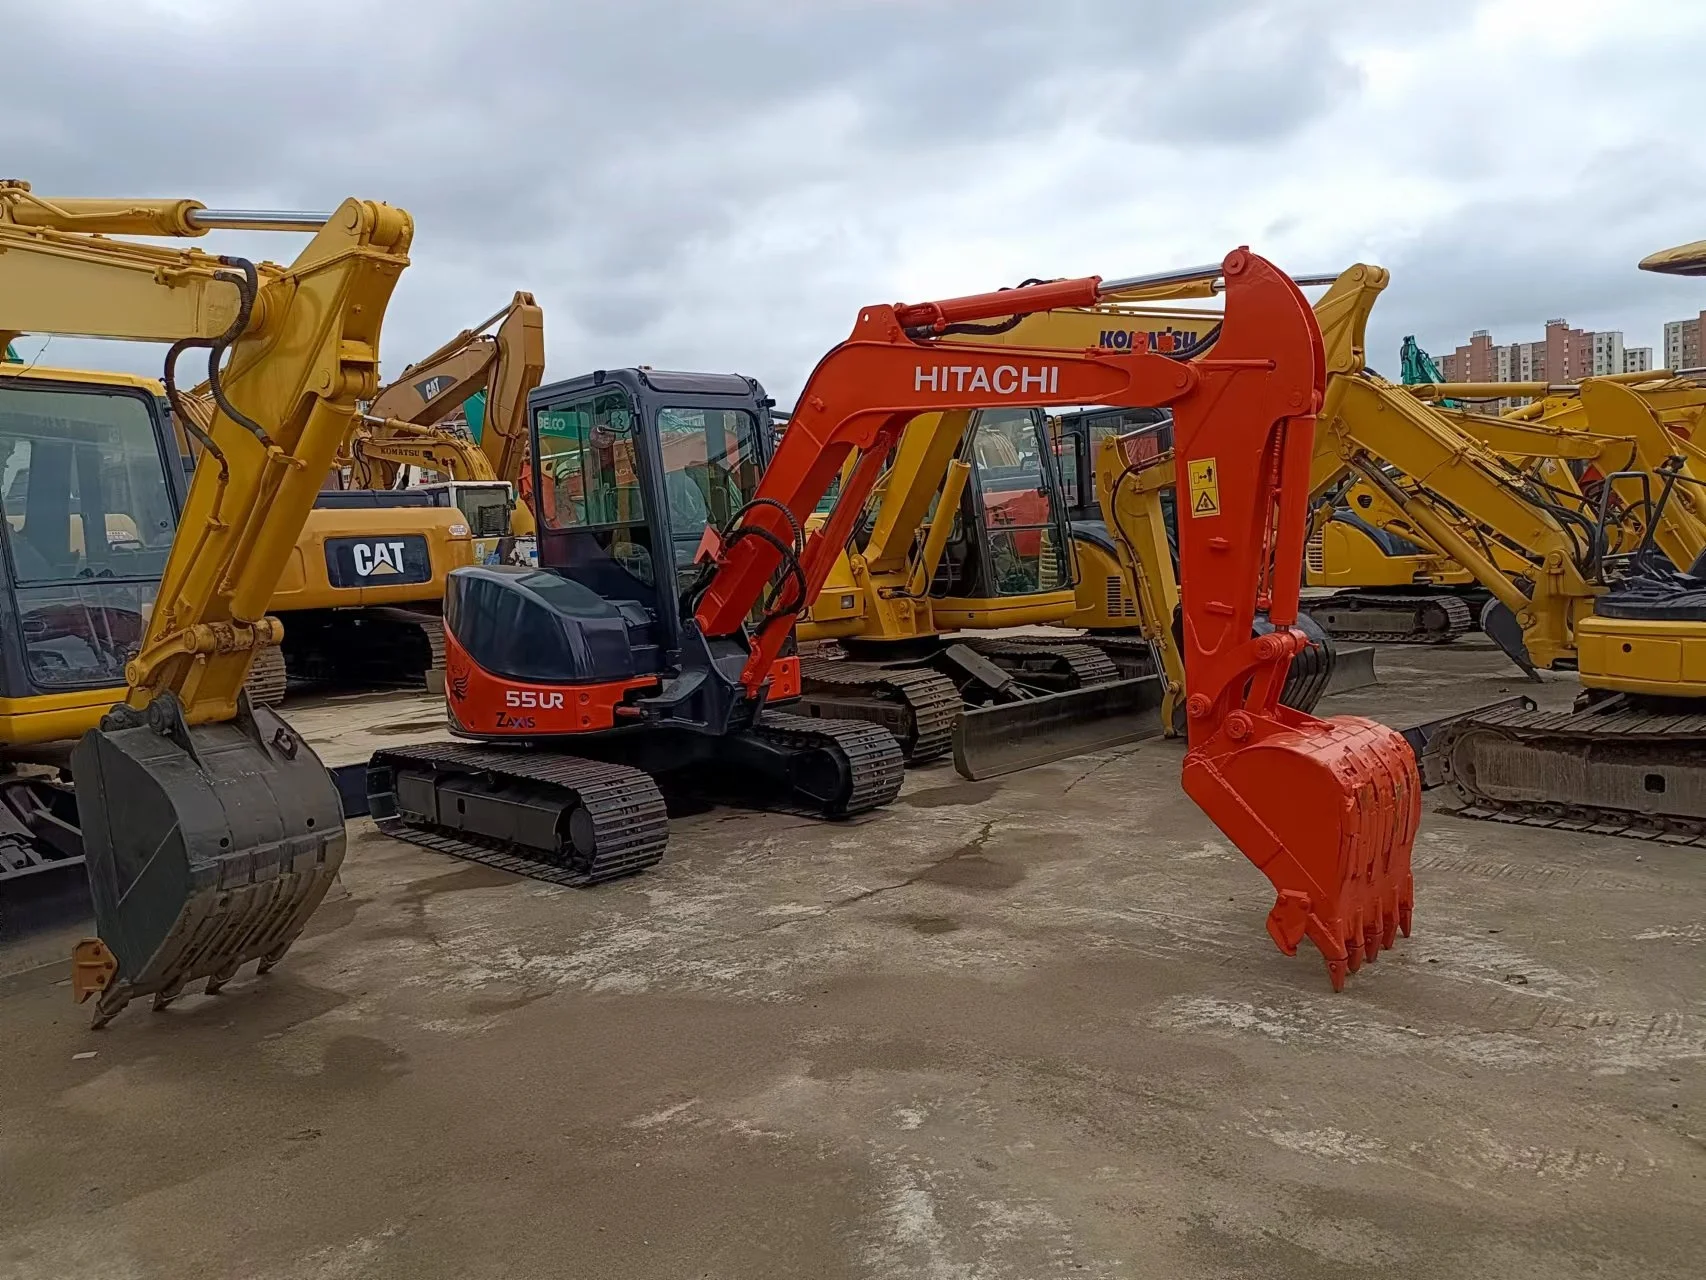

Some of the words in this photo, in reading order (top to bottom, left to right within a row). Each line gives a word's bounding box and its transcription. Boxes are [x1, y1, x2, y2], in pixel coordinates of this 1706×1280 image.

[425, 377, 440, 400] CAT
[914, 365, 1058, 394] HITACHI
[380, 447, 420, 457] KOMATSU
[353, 542, 405, 577] CAT
[506, 690, 564, 710] 55UR
